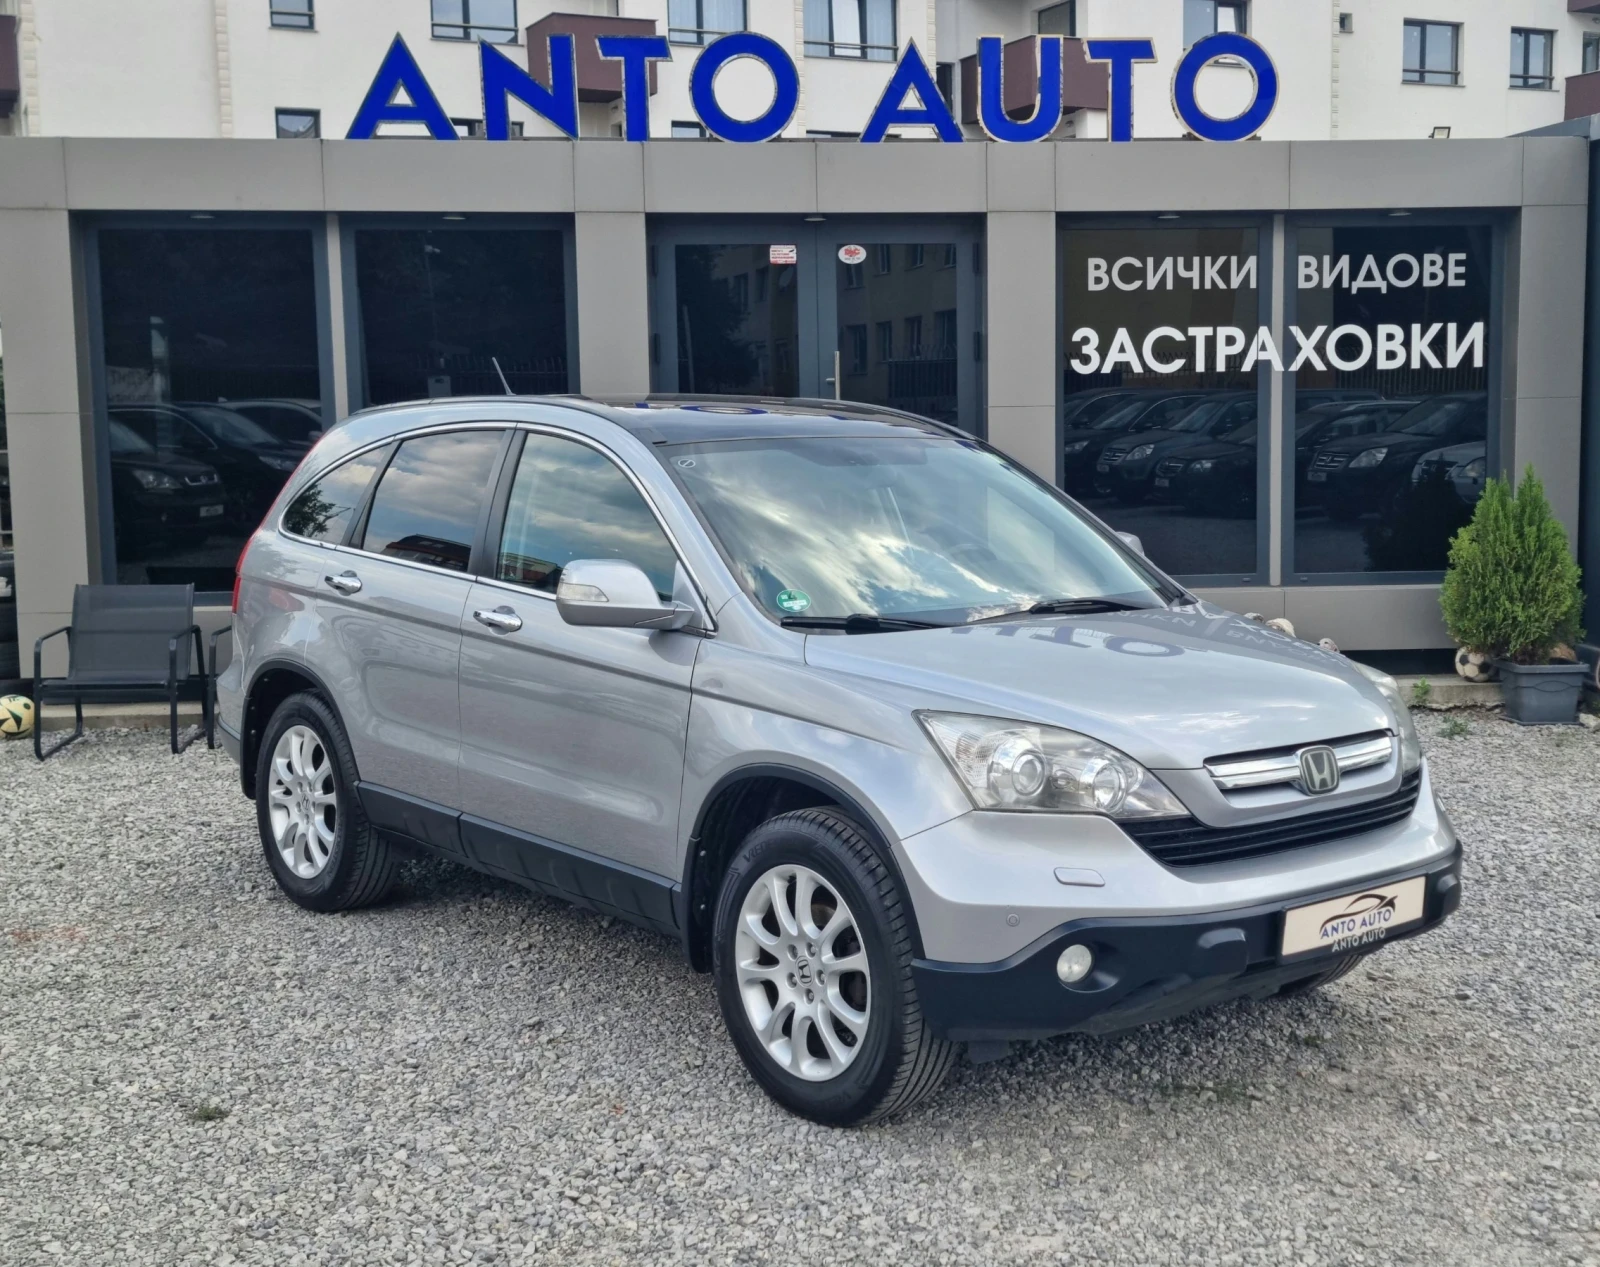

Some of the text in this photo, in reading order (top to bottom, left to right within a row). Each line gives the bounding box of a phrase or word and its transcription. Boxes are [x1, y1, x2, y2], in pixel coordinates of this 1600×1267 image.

[347, 31, 1279, 143] ANTO AUTO
[1087, 252, 1467, 295] ВСИЧКИ ВИДОВЕ
[1070, 321, 1485, 375] ЗАСТРАХОВКИ
[1320, 908, 1392, 940] ANTO AUTO
[1332, 927, 1386, 953] ANTO AUTO
